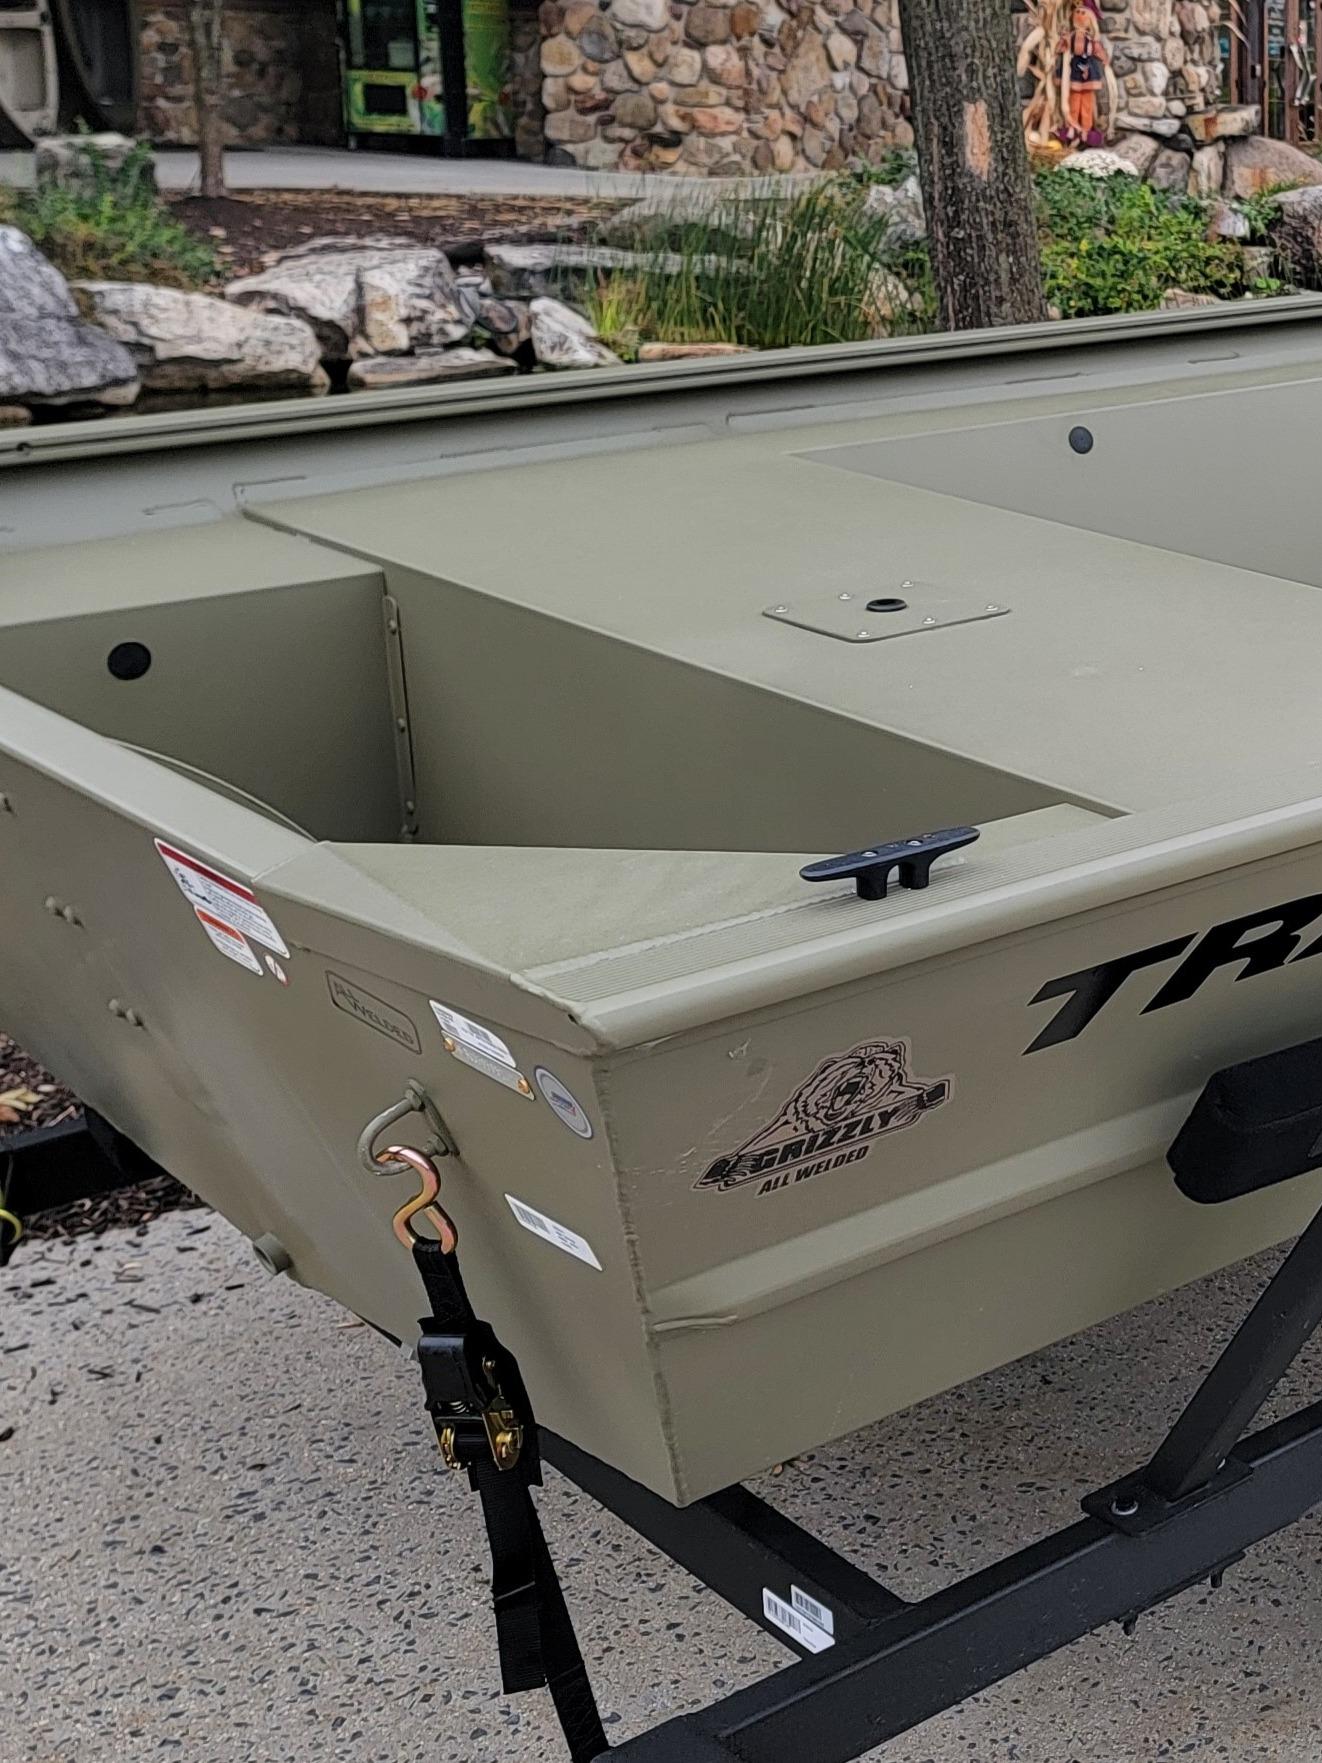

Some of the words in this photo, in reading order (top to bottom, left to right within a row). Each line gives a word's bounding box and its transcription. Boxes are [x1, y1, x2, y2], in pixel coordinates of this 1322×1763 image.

[750, 1105, 902, 1175] GRIZZLY
[756, 1173, 792, 1197] ALL
[794, 1145, 870, 1183] WELDED
